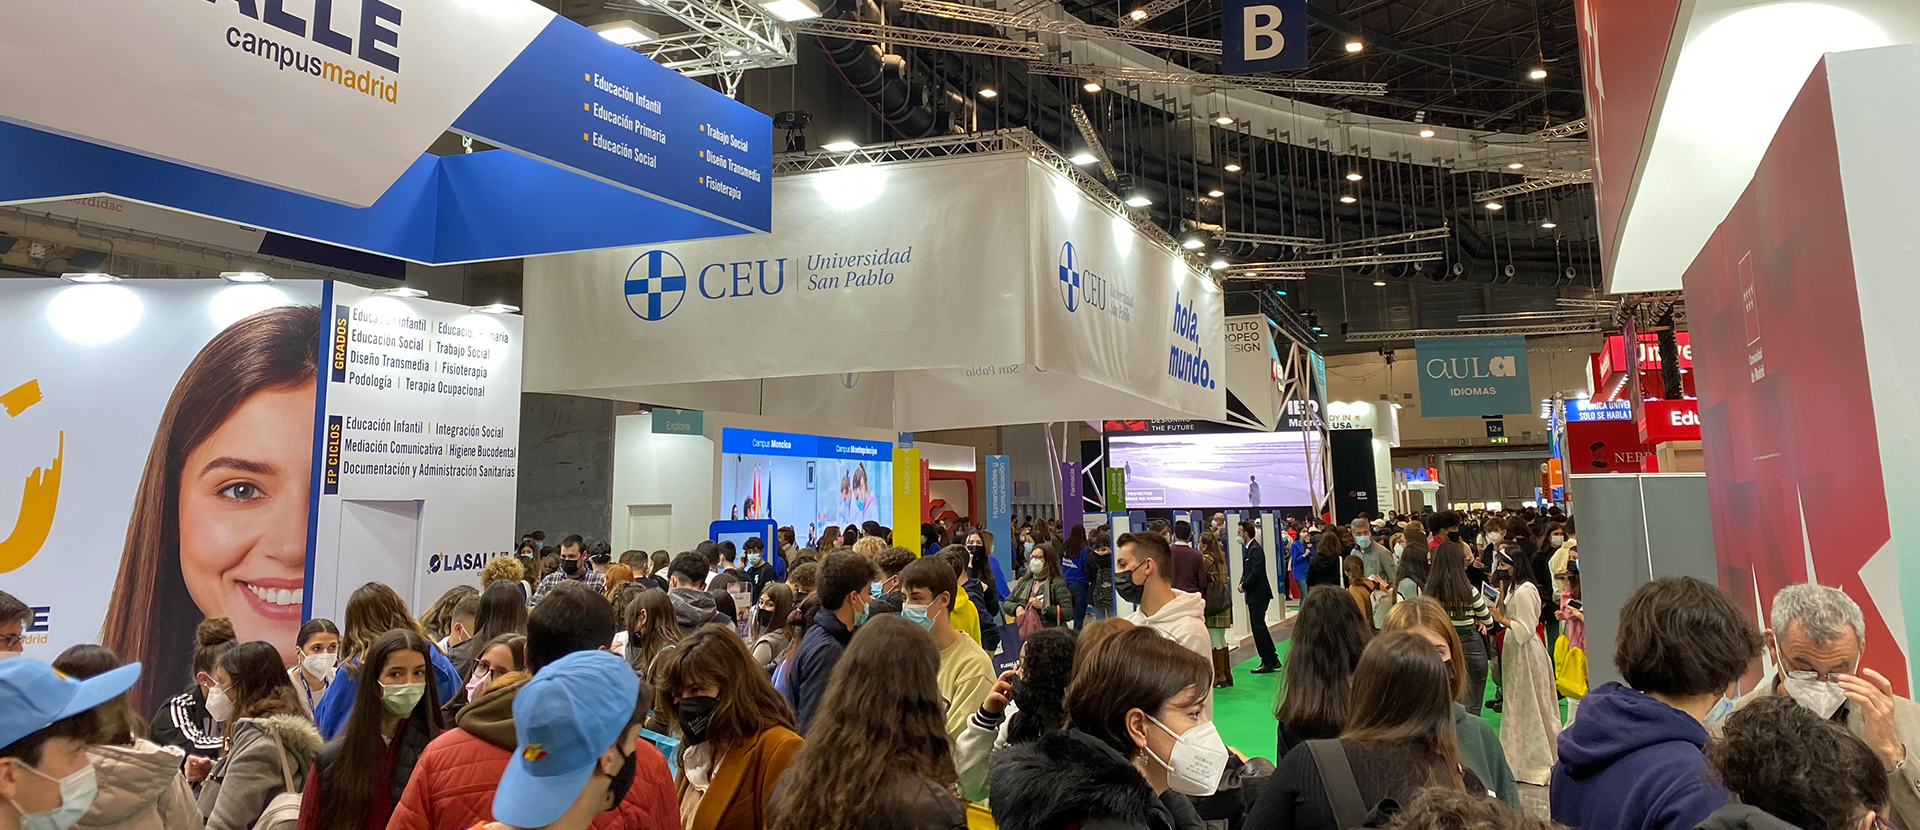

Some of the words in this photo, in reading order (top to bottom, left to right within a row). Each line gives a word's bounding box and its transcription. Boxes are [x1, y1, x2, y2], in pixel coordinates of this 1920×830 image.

[1244, 4, 1284, 60] B
[226, 26, 398, 104] campusmadrid
[594, 73, 634, 103] Educación
[636, 92, 662, 115] Infantil
[593, 102, 633, 132] Educación
[635, 119, 666, 145] Primaria
[706, 123, 729, 146] Trabajo
[730, 133, 748, 153] Social
[592, 131, 633, 160] Educación
[634, 149, 657, 169] Social
[706, 149, 727, 169] Diseño
[728, 158, 761, 183] Transmedia
[706, 175, 742, 200] Fisioterapia
[698, 257, 787, 300] CEU
[807, 246, 912, 271] Universidad
[807, 273, 840, 291] San
[844, 269, 895, 288] Pablo
[1082, 269, 1107, 311] CEU
[398, 316, 427, 332] Infantil
[1173, 290, 1200, 350] hola,
[334, 317, 347, 370] GRADOS
[351, 328, 396, 347] Educación
[398, 335, 424, 351] Social
[436, 340, 465, 358] Trabajo
[467, 345, 490, 360] Social
[350, 349, 380, 366] Diseño
[382, 353, 429, 372] Transmedia
[442, 361, 488, 380] Fisioterapia
[1168, 344, 1216, 390] mundo.
[349, 371, 392, 390] Podología
[406, 377, 435, 394] Terapia
[437, 380, 485, 397] Ocupacional
[1450, 386, 1497, 396] IDIOMAS
[346, 416, 391, 432] Educación
[393, 419, 423, 434] Infantil
[436, 422, 480, 438] Integración
[481, 425, 504, 438] Social
[1579, 411, 1596, 420] SOLO
[1597, 411, 1606, 420] SE
[1607, 410, 1628, 419] HABLA
[328, 424, 340, 465] CICLOS
[344, 438, 388, 453] Mediación
[390, 440, 443, 455] Comunicativa
[449, 444, 476, 459] Higiene
[477, 445, 516, 458] Bucodental
[752, 438, 771, 450] Campus
[771, 439, 792, 449] Moncloa
[327, 469, 337, 484] FP
[343, 460, 410, 476] Documentación
[412, 465, 417, 478] y
[419, 463, 477, 477] Administración
[479, 464, 515, 478] Sanitarias
[991, 468, 999, 519] Humanidades
